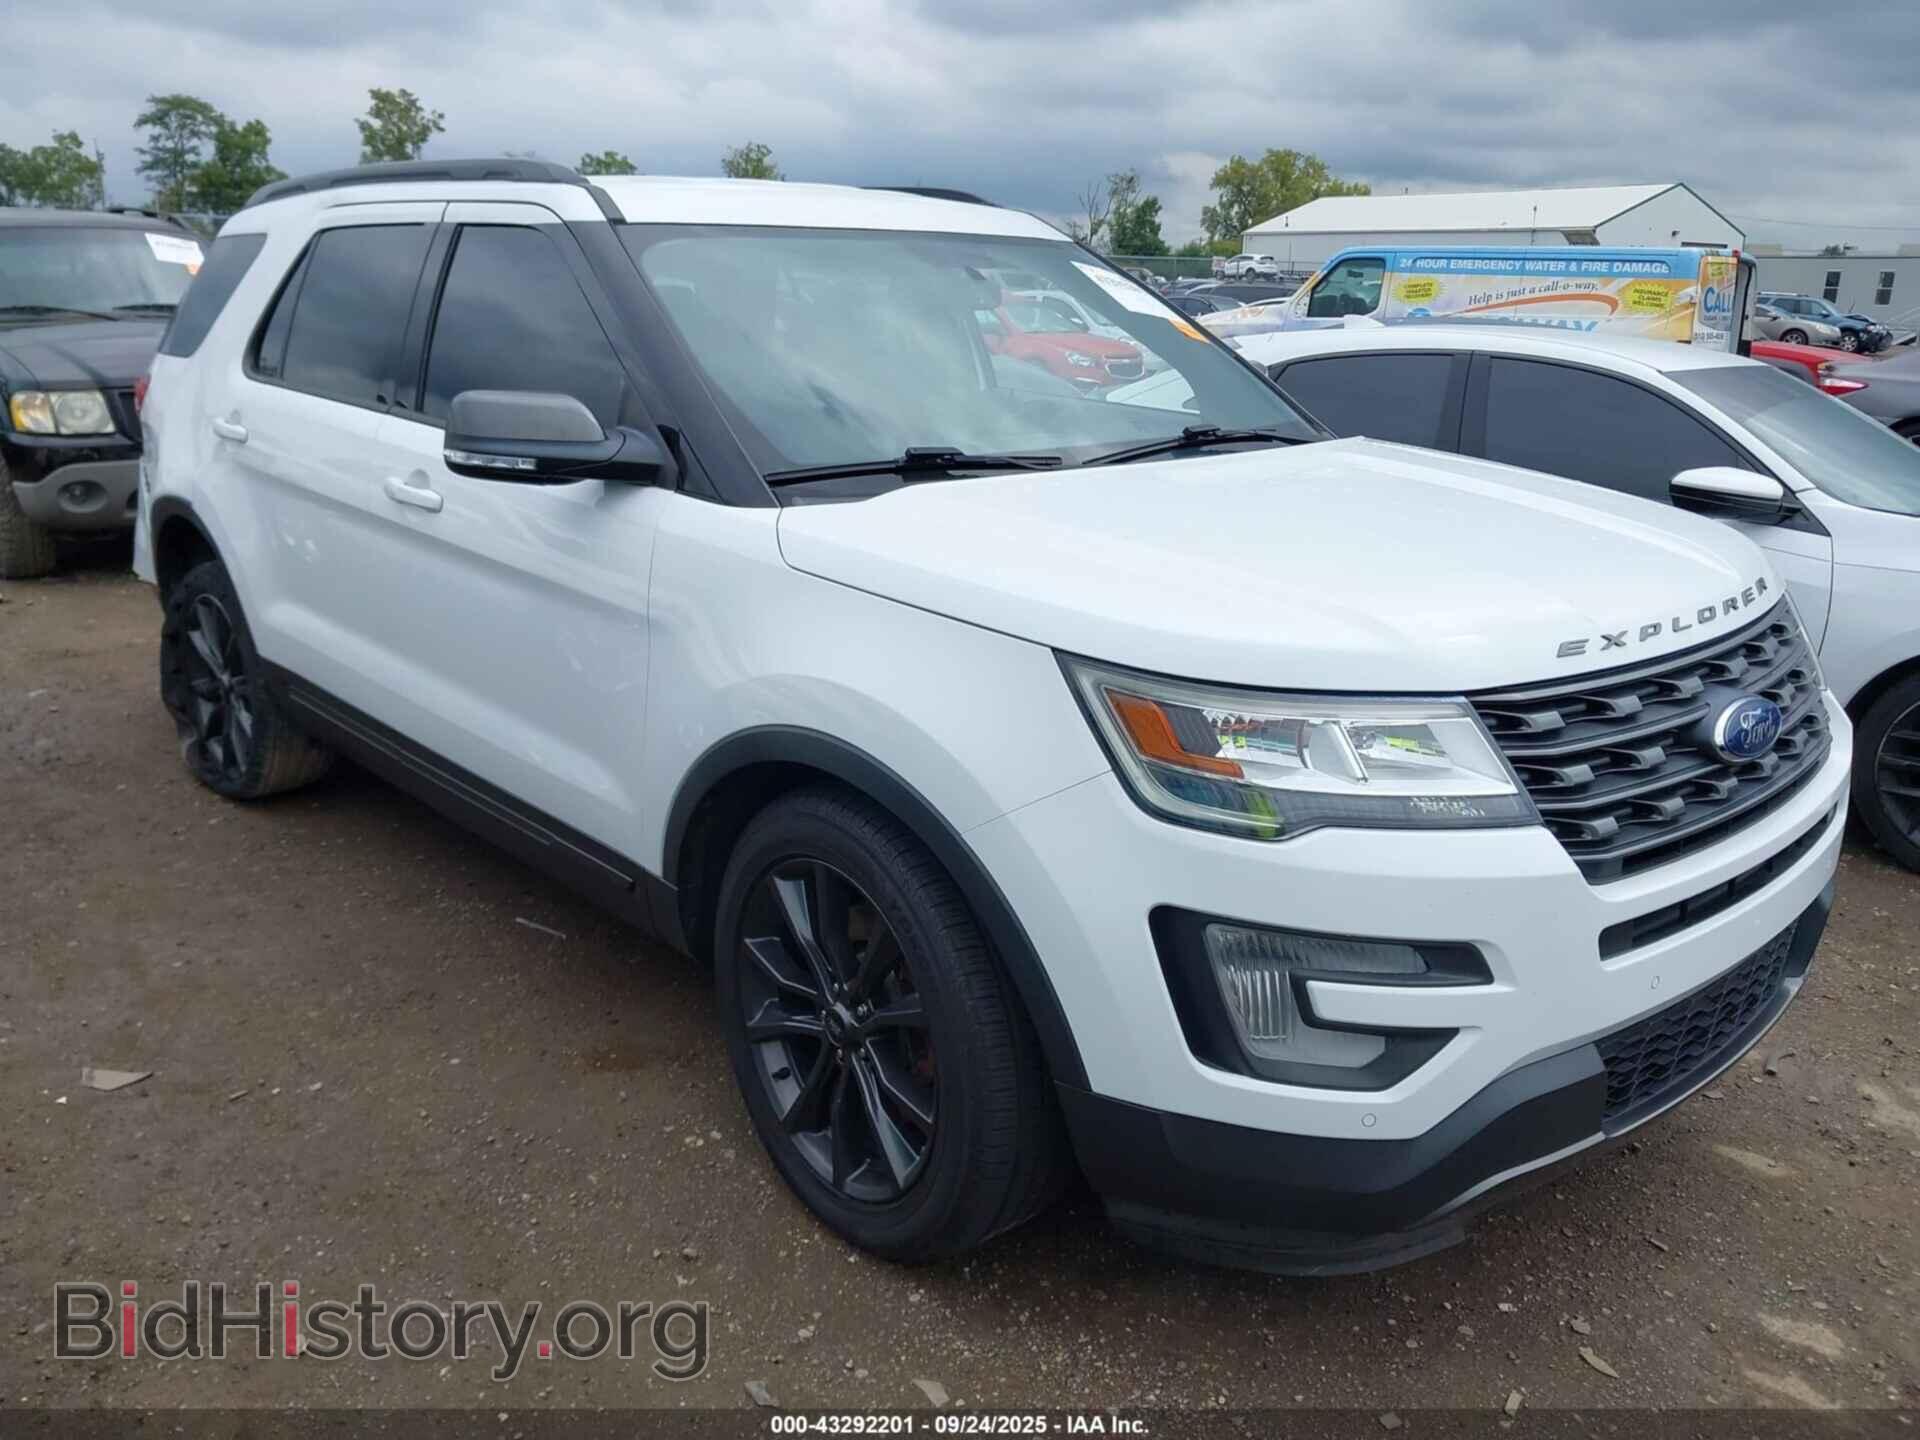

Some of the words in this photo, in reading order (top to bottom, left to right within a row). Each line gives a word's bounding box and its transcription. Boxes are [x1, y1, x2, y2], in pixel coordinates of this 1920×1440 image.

[1400, 258, 1411, 268] 24
[1416, 258, 1448, 269] HOUR
[1450, 259, 1522, 271] EMERGENCY
[1524, 260, 1566, 272] WATER
[1569, 261, 1578, 272] &
[1581, 261, 1610, 273] FIRE
[1613, 262, 1670, 274] DAMAGE
[1468, 291, 1493, 306] Help
[1496, 290, 1504, 300] is
[1505, 286, 1526, 301] just
[1528, 286, 1537, 294] a
[1556, 576, 1769, 658] EXPLORER
[1739, 707, 1775, 749] Ford
